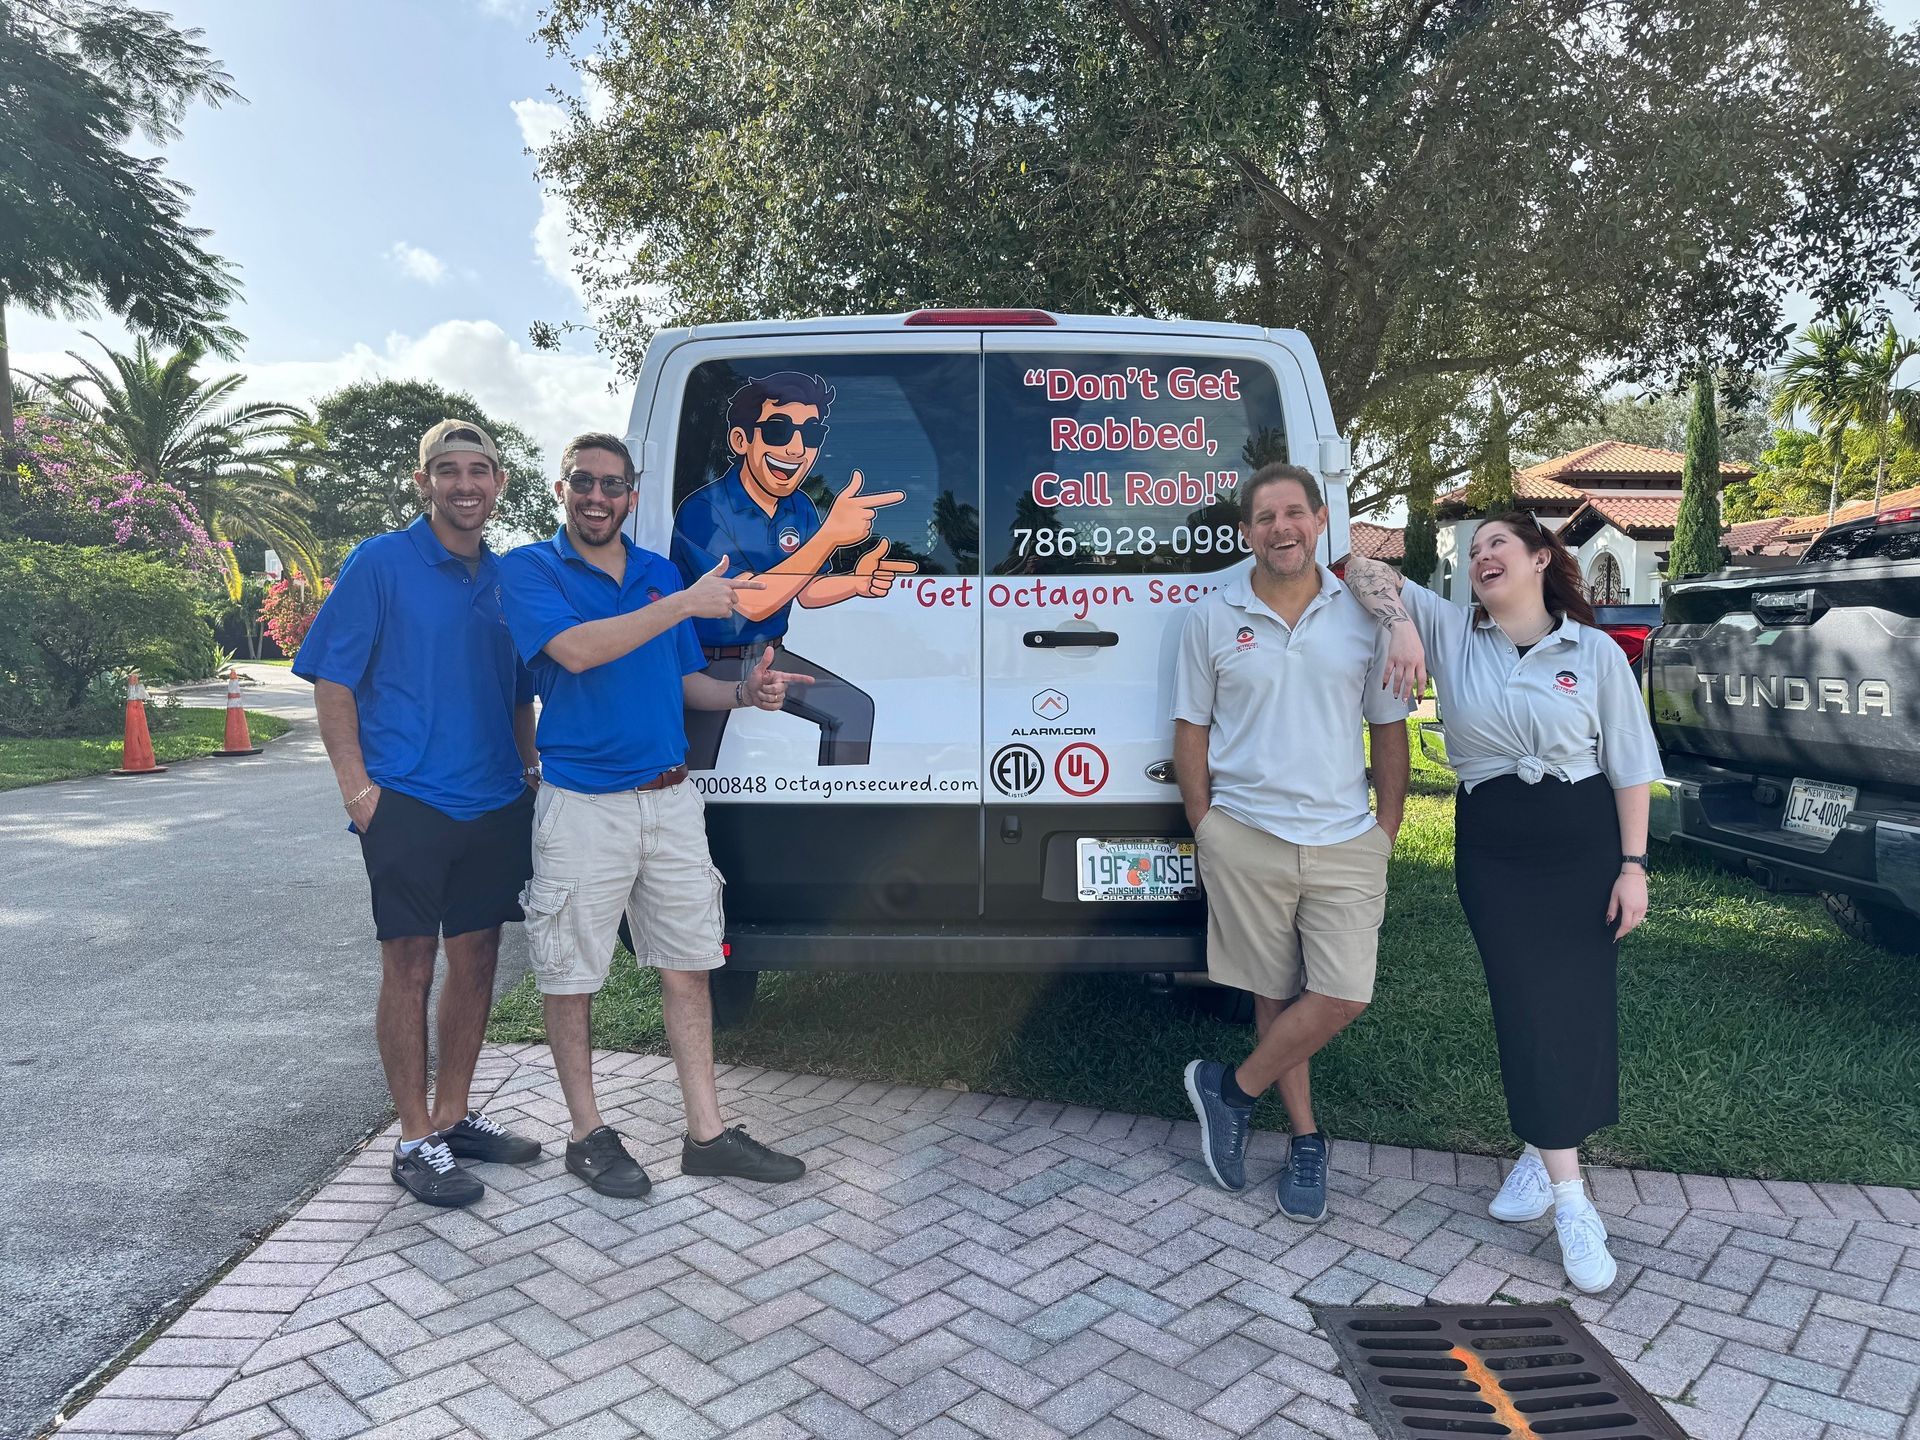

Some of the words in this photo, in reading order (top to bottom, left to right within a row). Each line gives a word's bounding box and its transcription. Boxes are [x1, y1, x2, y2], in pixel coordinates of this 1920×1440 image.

[1168, 367, 1241, 400] Get
[1051, 417, 1218, 456] Robbed,
[1032, 472, 1112, 507] Call
[1125, 471, 1238, 506] Rob!”
[900, 578, 973, 608] “Get
[988, 578, 1134, 619] Octagon
[1697, 672, 1892, 717] TUNDRA
[1011, 727, 1096, 736] ALARM.COM
[1067, 754, 1095, 785] UL
[689, 776, 767, 794] 000848
[774, 774, 979, 798] Octagonsecured.com
[1807, 788, 1822, 798] NEW
[1823, 790, 1840, 801] YORK
[1790, 796, 1814, 822] LJZ
[1818, 801, 1847, 828] 4080
[1088, 856, 1126, 884] 19F
[1153, 855, 1194, 884] QSE
[1107, 886, 1146, 895] SUNSHINE
[1149, 886, 1174, 895] STATE
